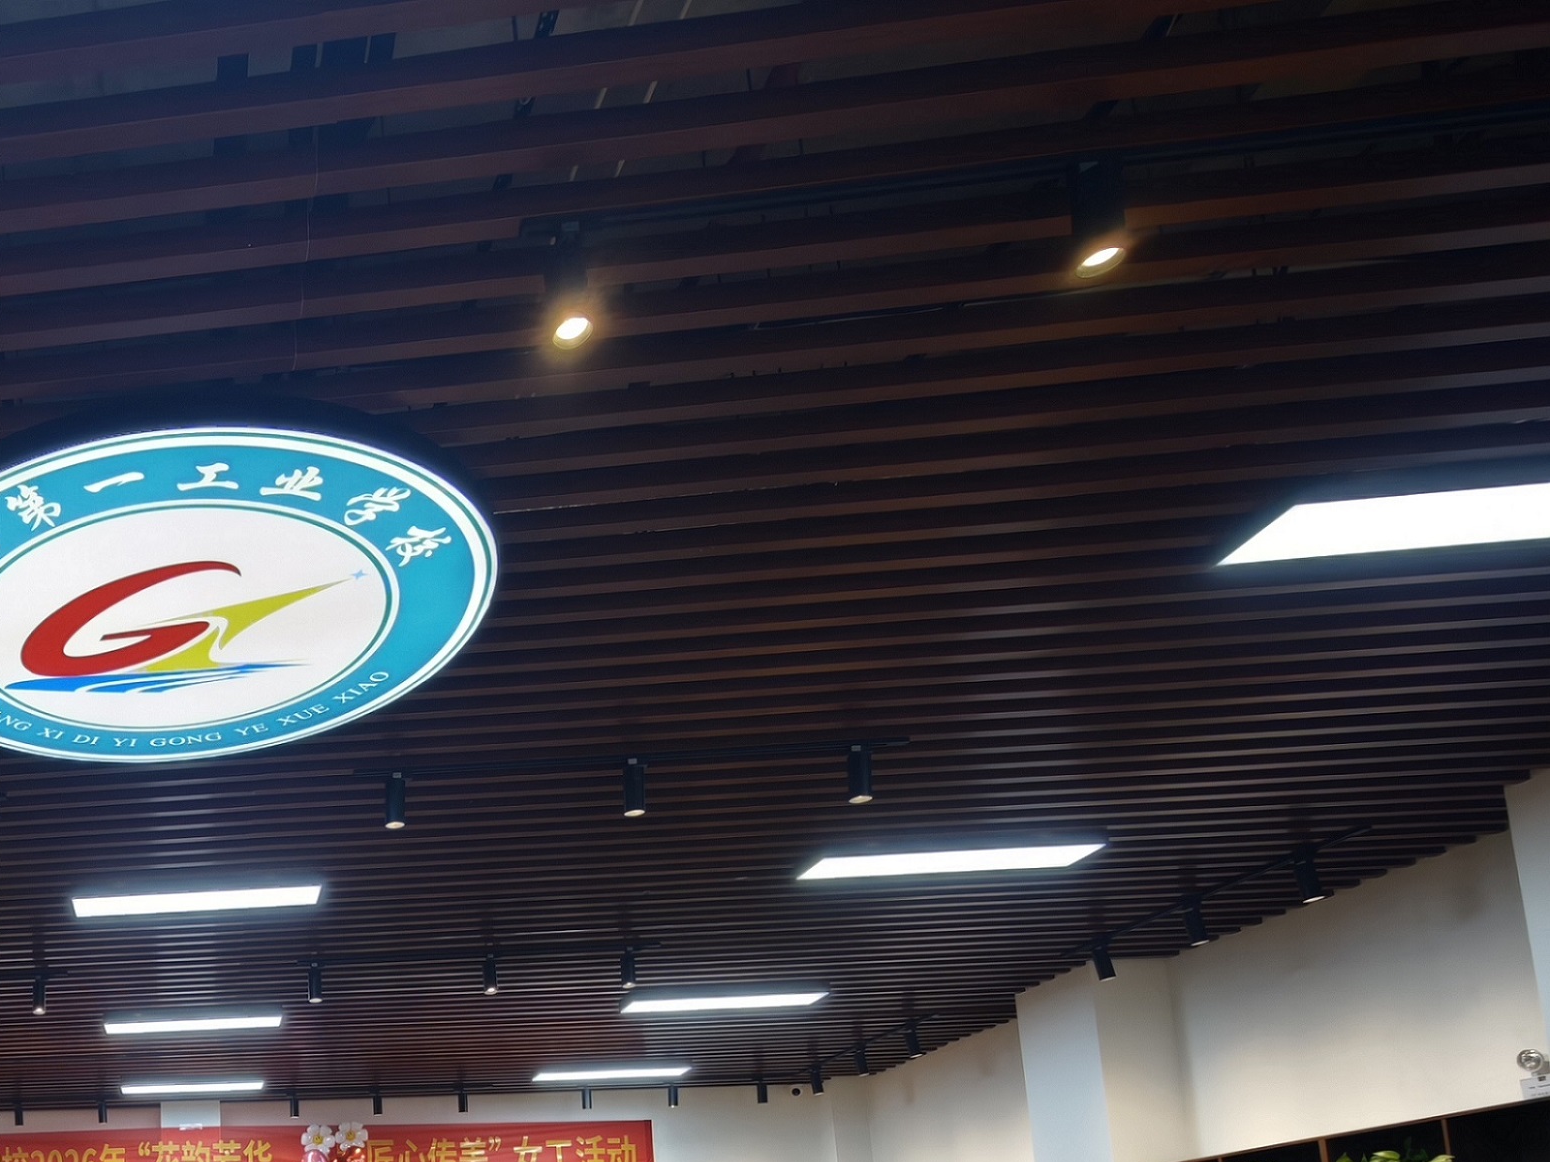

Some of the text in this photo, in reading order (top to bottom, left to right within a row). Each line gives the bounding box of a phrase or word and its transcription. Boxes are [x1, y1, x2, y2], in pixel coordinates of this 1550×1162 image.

[37, 726, 65, 741] XI
[71, 733, 99, 746] DI
[112, 737, 138, 748] YI
[149, 731, 223, 748] GONG
[234, 721, 270, 737] YE
[276, 703, 330, 727] XUE
[331, 670, 390, 704] XIAO
